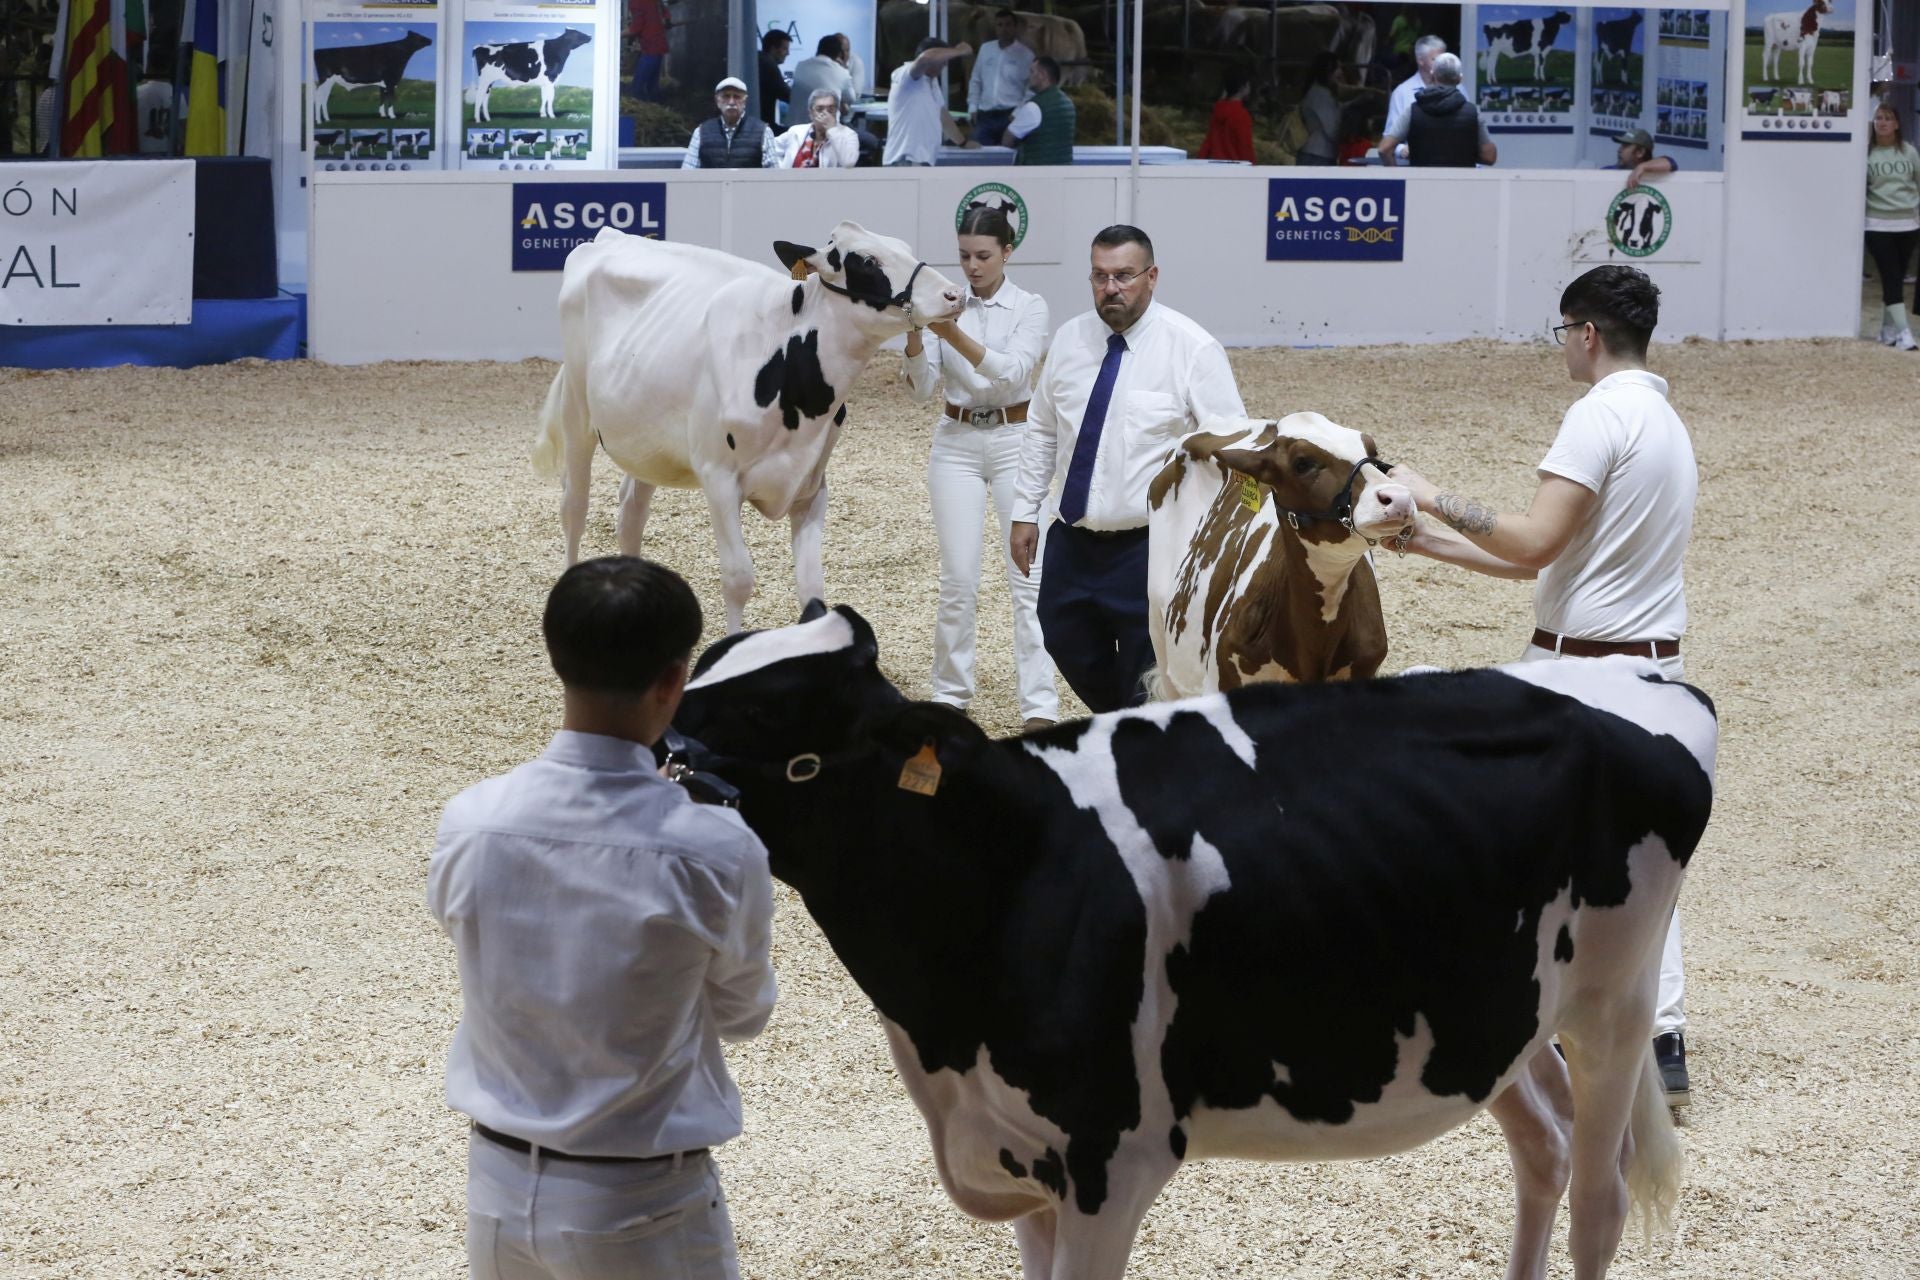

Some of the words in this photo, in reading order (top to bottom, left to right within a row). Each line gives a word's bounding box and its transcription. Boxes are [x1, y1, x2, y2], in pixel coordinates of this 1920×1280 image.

[521, 202, 659, 229] ASCOL
[1275, 197, 1399, 222] ASCOL
[1276, 230, 1341, 241] GENETICS
[2, 245, 80, 288] AL
